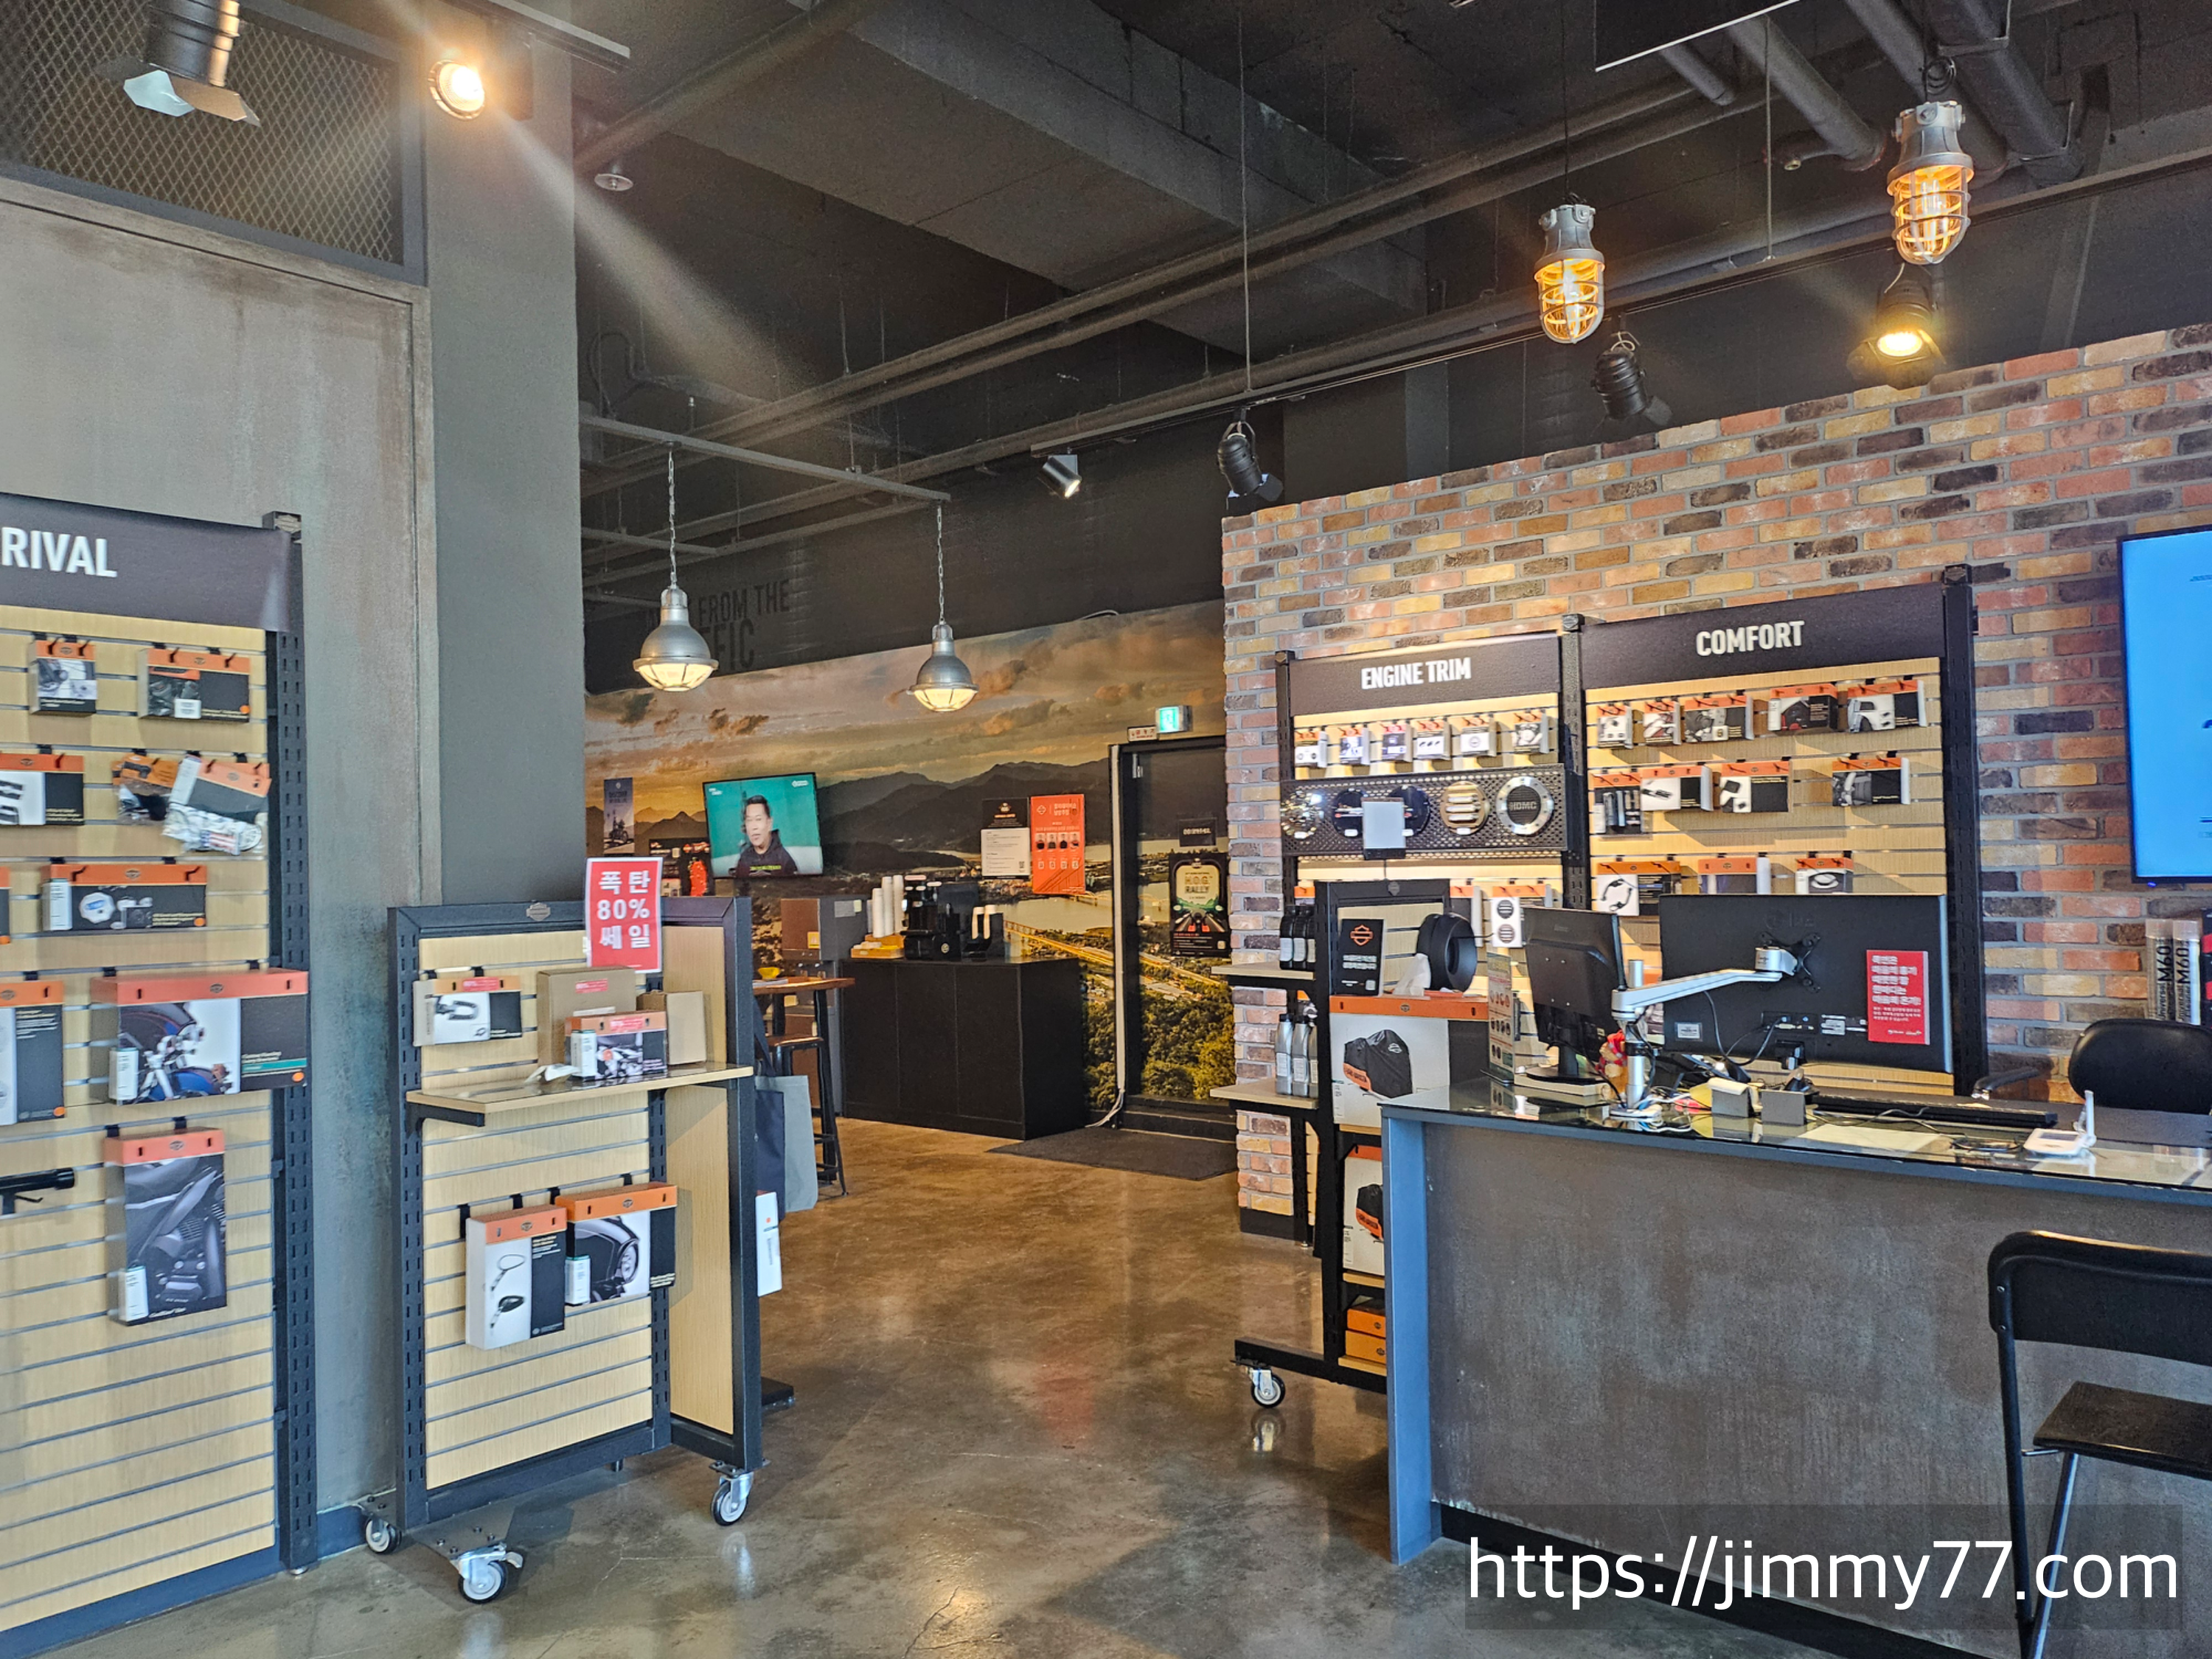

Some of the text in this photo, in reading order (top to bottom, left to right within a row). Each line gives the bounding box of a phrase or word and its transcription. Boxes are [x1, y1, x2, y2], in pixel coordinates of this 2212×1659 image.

[1, 526, 117, 577] RIVAL
[699, 580, 790, 626] FROM THE
[1696, 620, 1804, 656] COMFORT
[1360, 657, 1472, 689] ENGINE TRIM
[597, 898, 650, 920] 80%
[2156, 945, 2172, 982] M60
[2176, 947, 2191, 984] M60
